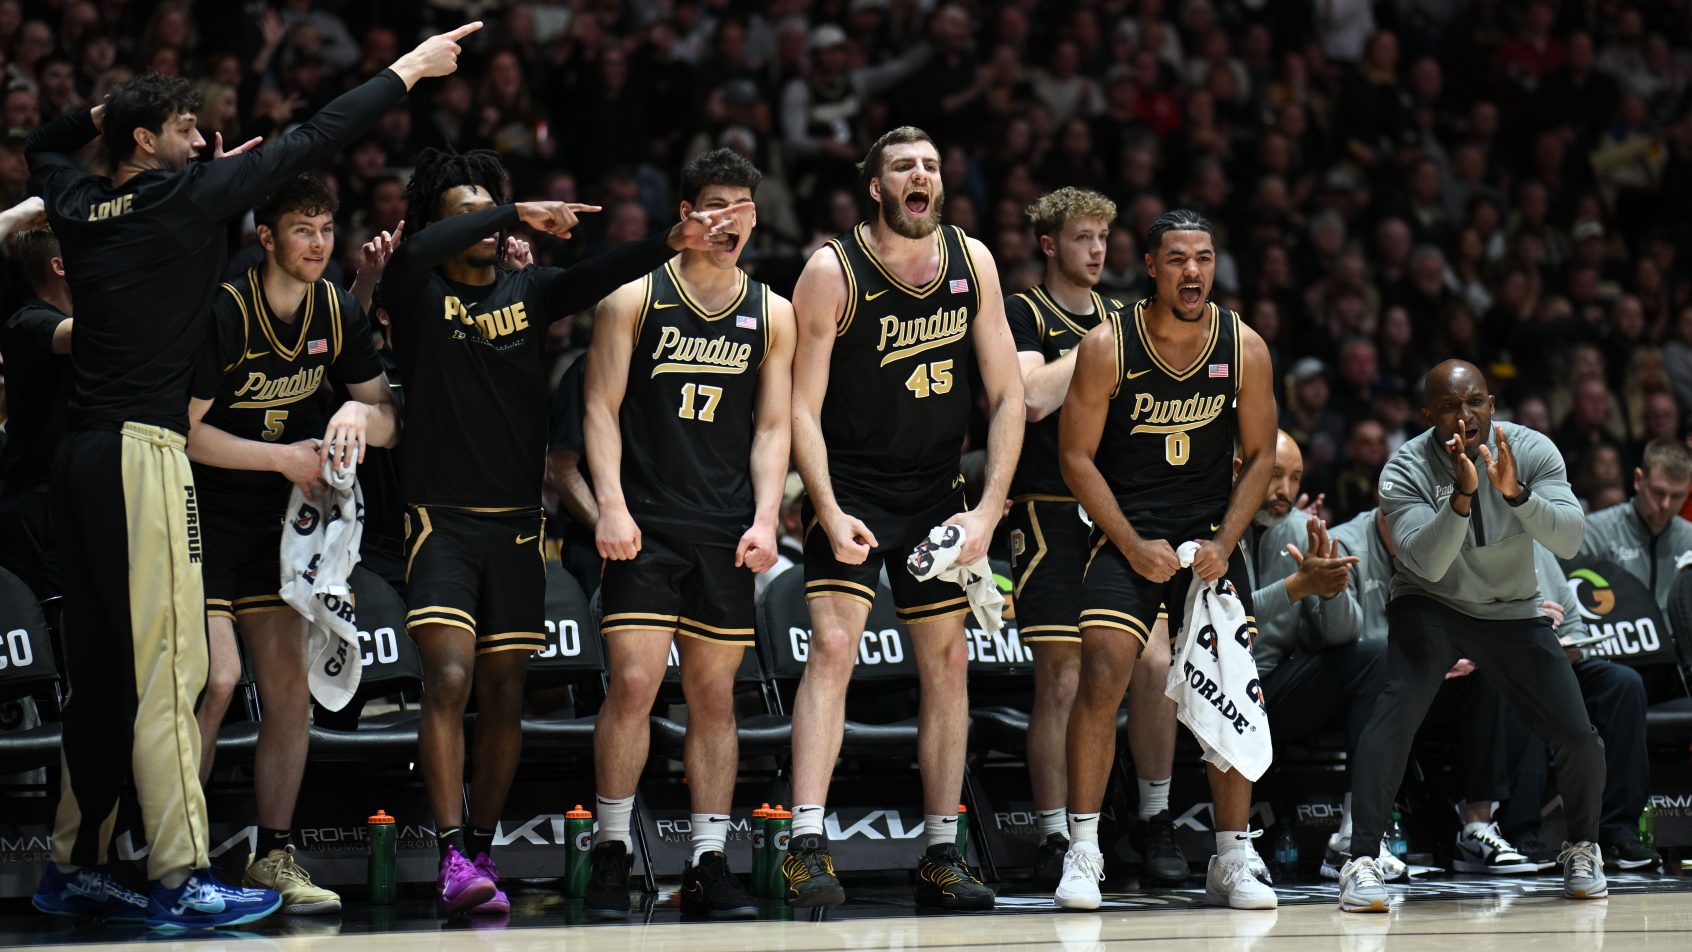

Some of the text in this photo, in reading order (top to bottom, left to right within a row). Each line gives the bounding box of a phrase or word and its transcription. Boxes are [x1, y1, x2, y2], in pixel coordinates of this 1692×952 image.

[88, 194, 134, 222] LOVE
[444, 295, 529, 341] PUDUE
[878, 306, 968, 352] Purdue
[652, 326, 752, 374] Purdue
[234, 364, 325, 402] Purdue
[905, 359, 954, 399] 45
[678, 382, 723, 423] 17
[1130, 392, 1226, 426] Purdue
[261, 409, 289, 441] 5
[1165, 431, 1191, 466] 0
[183, 484, 203, 565] PURDUE
[1183, 660, 1250, 736] TORADE
